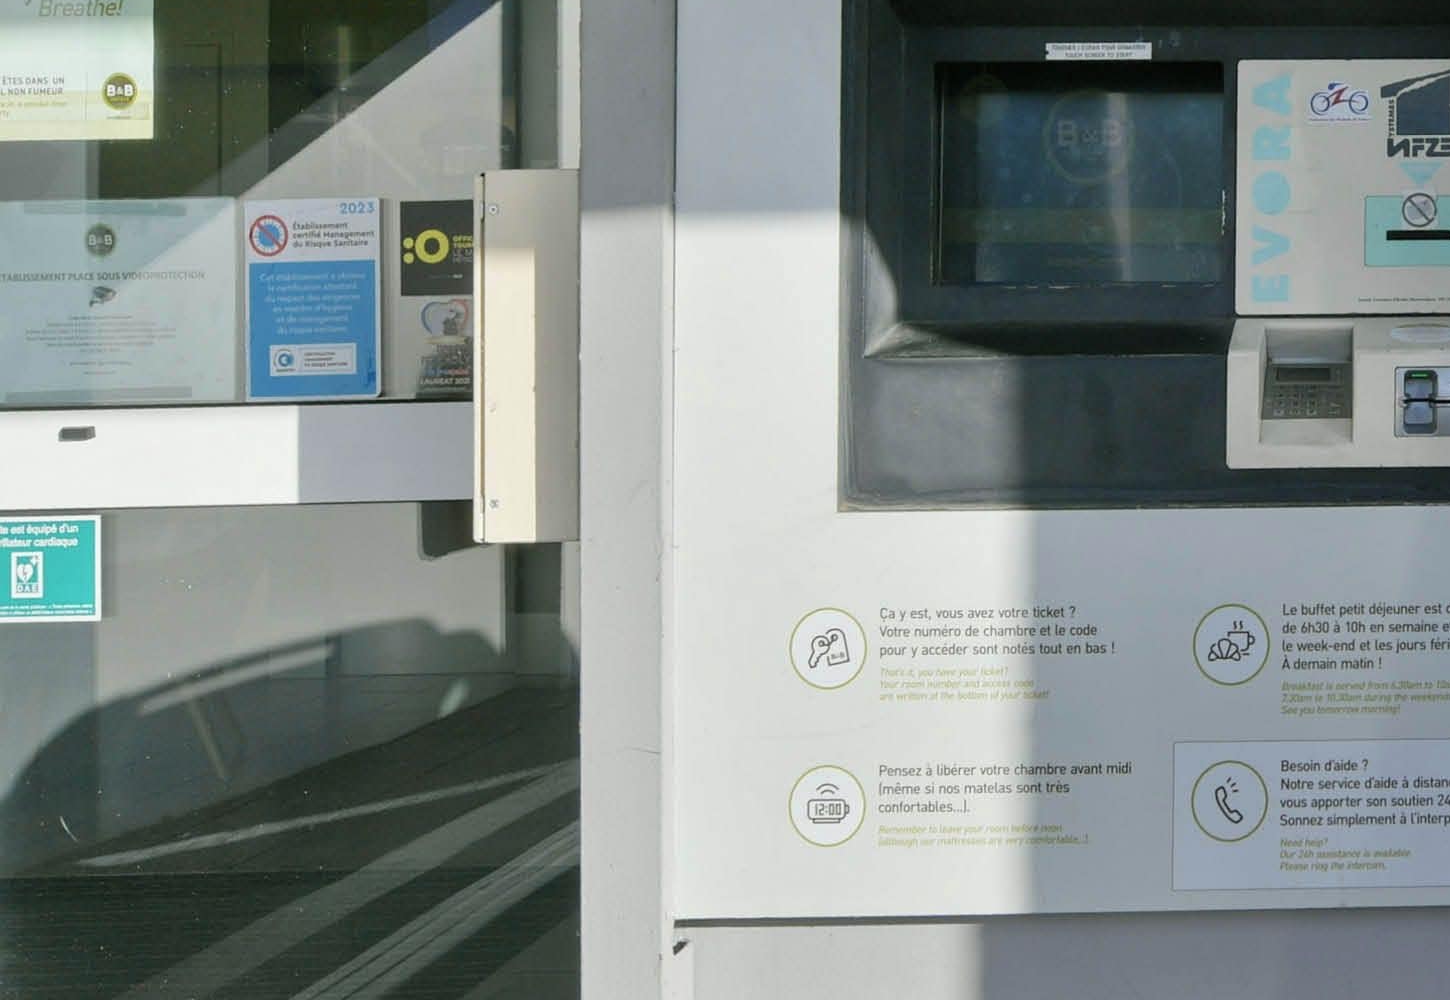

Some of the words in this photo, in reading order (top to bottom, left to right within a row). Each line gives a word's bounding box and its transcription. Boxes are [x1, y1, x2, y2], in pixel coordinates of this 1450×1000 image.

[25, 77, 48, 85] DANS
[53, 76, 64, 85] UN
[8, 87, 26, 96] NON
[28, 87, 63, 96] FUMEUR
[1251, 72, 1292, 301] EVORA
[340, 202, 375, 214] 2023
[0, 272, 65, 281] TABLISSEMENT
[1282, 603, 1298, 616] Le
[1301, 603, 1336, 619] buffet
[1338, 603, 1365, 619] petit
[1368, 602, 1422, 618] déjeuner
[1424, 603, 1442, 615] est
[1282, 621, 1298, 634] de
[1301, 620, 1330, 634] 6h30
[1334, 621, 1341, 633] à
[1344, 620, 1366, 634] 10h
[1370, 622, 1384, 632] en
[1388, 620, 1439, 632] semaine
[1282, 654, 1290, 670] À
[1293, 657, 1337, 670] demain
[1341, 655, 1374, 670] matin
[879, 764, 922, 777] Pensez
[925, 764, 932, 776] à
[936, 764, 976, 776] libérer
[980, 764, 1010, 776] votre
[1014, 762, 1067, 777] chambre
[1070, 763, 1105, 775] avant
[1106, 762, 1132, 775] midi
[1281, 760, 1320, 772] Besoin
[1324, 760, 1358, 772] d'aide
[1281, 778, 1314, 790] Notre
[1318, 776, 1361, 790] service
[1364, 776, 1398, 789] d'aide
[1402, 776, 1409, 788] à
[878, 798, 970, 815] confortables...).
[1280, 798, 1308, 808] vous
[1310, 793, 1363, 810] apporter
[1366, 797, 1387, 808] son
[1391, 794, 1434, 808] soutien
[1280, 814, 1324, 827] Sonnez
[1326, 812, 1396, 828] simplement
[1400, 812, 1407, 824] à
